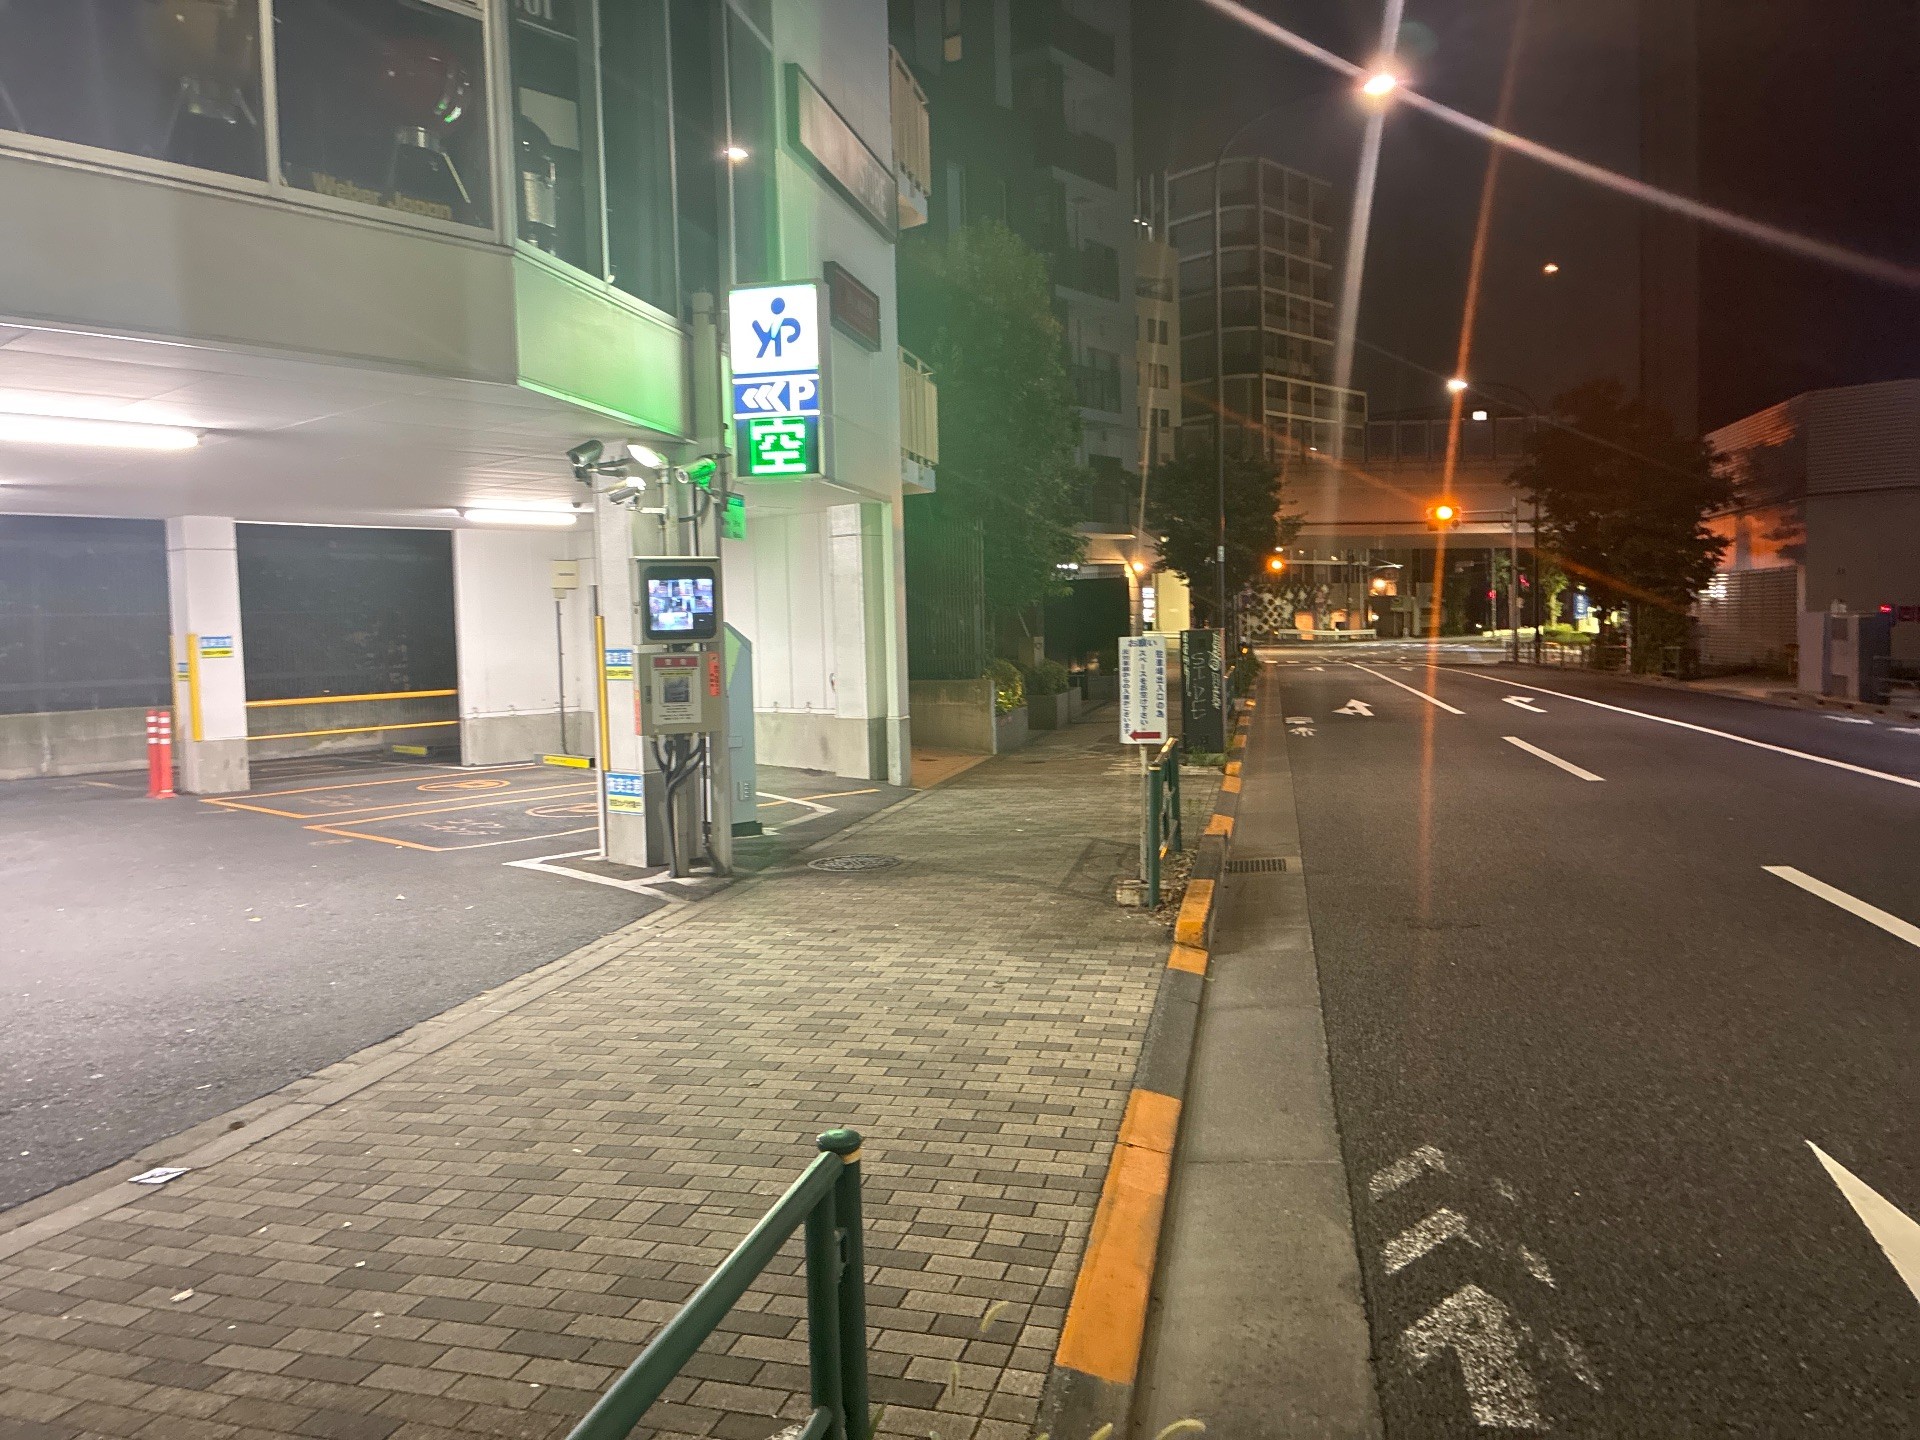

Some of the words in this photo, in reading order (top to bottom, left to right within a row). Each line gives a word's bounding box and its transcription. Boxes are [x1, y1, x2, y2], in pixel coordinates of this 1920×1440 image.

[789, 381, 815, 412] P
[751, 418, 806, 473] 空
[1128, 638, 1157, 647] お願い
